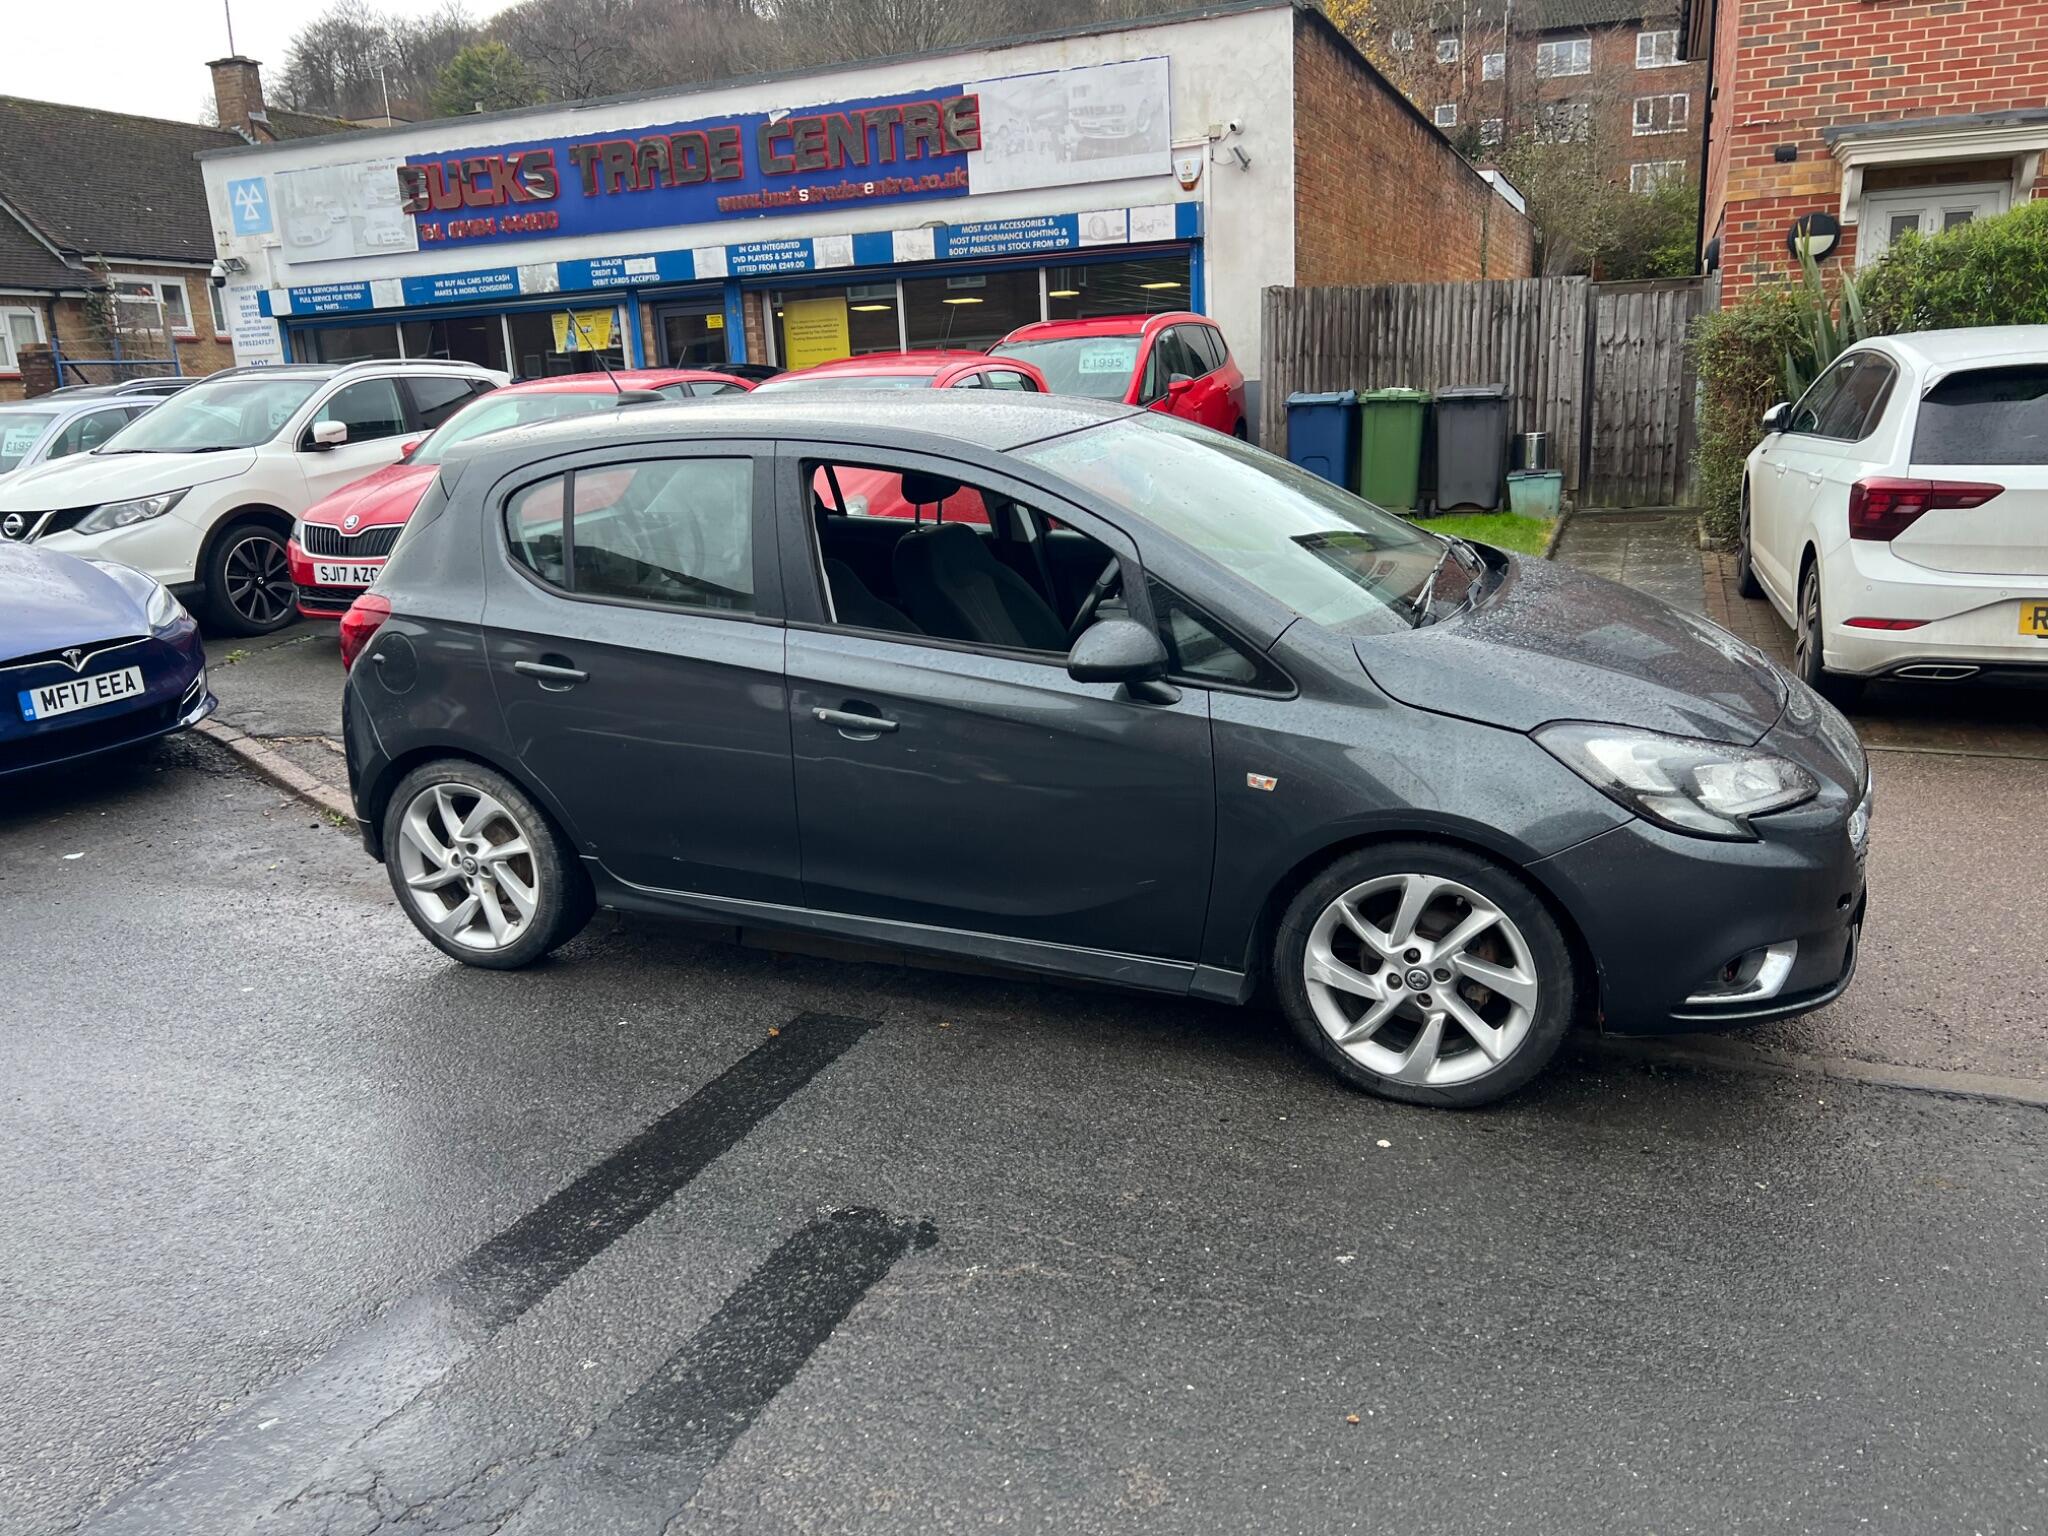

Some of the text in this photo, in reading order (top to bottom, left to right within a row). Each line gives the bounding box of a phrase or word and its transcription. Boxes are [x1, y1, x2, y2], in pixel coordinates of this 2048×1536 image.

[397, 94, 981, 216] BUCKS TRADE CENTRE
[961, 225, 982, 234] MOST
[999, 217, 1047, 231] ACCESSORIES
[1048, 218, 1055, 226] &
[950, 228, 1068, 246] MOST PERFORMANCE LIGHTING &
[738, 241, 800, 254] IN CAR INTEGRATED
[948, 238, 1070, 256] BODY PANELS IN STOCK FROM £99
[590, 258, 623, 268] ALL MAJOR
[732, 249, 809, 264] DVD PLAYERS & SAT NAV
[590, 268, 611, 277] CREDIT
[736, 263, 757, 273] FITTED
[758, 262, 777, 271] FROM
[434, 273, 511, 288] WE BUY ALL CARS FOR CASH
[631, 273, 660, 284] ACCEPTED
[434, 282, 514, 297] MAKES & MODEL CONSIDERED
[240, 303, 259, 311] SERVIC
[1082, 358, 1122, 369] £1995
[320, 566, 347, 582] SJ17
[40, 670, 137, 712] MF17 EEA
